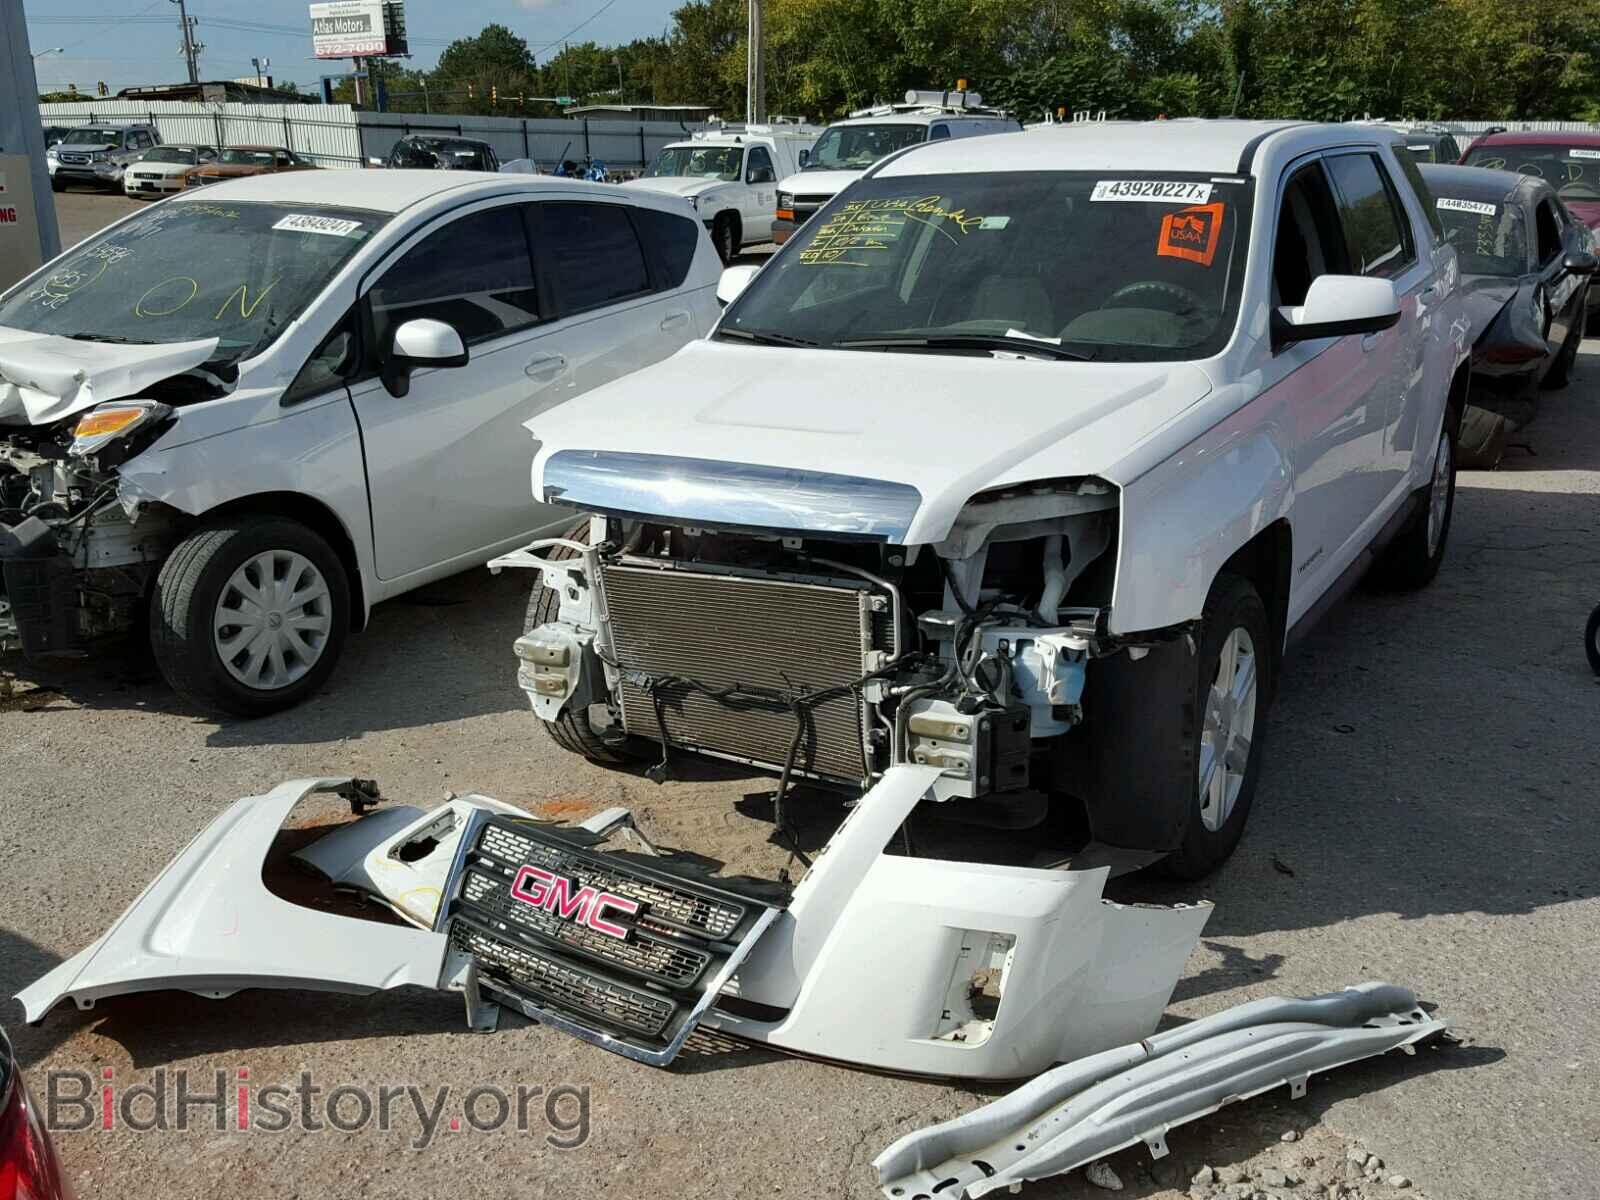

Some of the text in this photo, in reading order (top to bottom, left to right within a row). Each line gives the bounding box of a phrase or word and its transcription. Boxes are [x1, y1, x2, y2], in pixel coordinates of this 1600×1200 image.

[313, 18, 334, 35] Atlas
[335, 17, 363, 33] Motors
[1171, 228, 1201, 244] USAA
[510, 864, 640, 940] GMC
